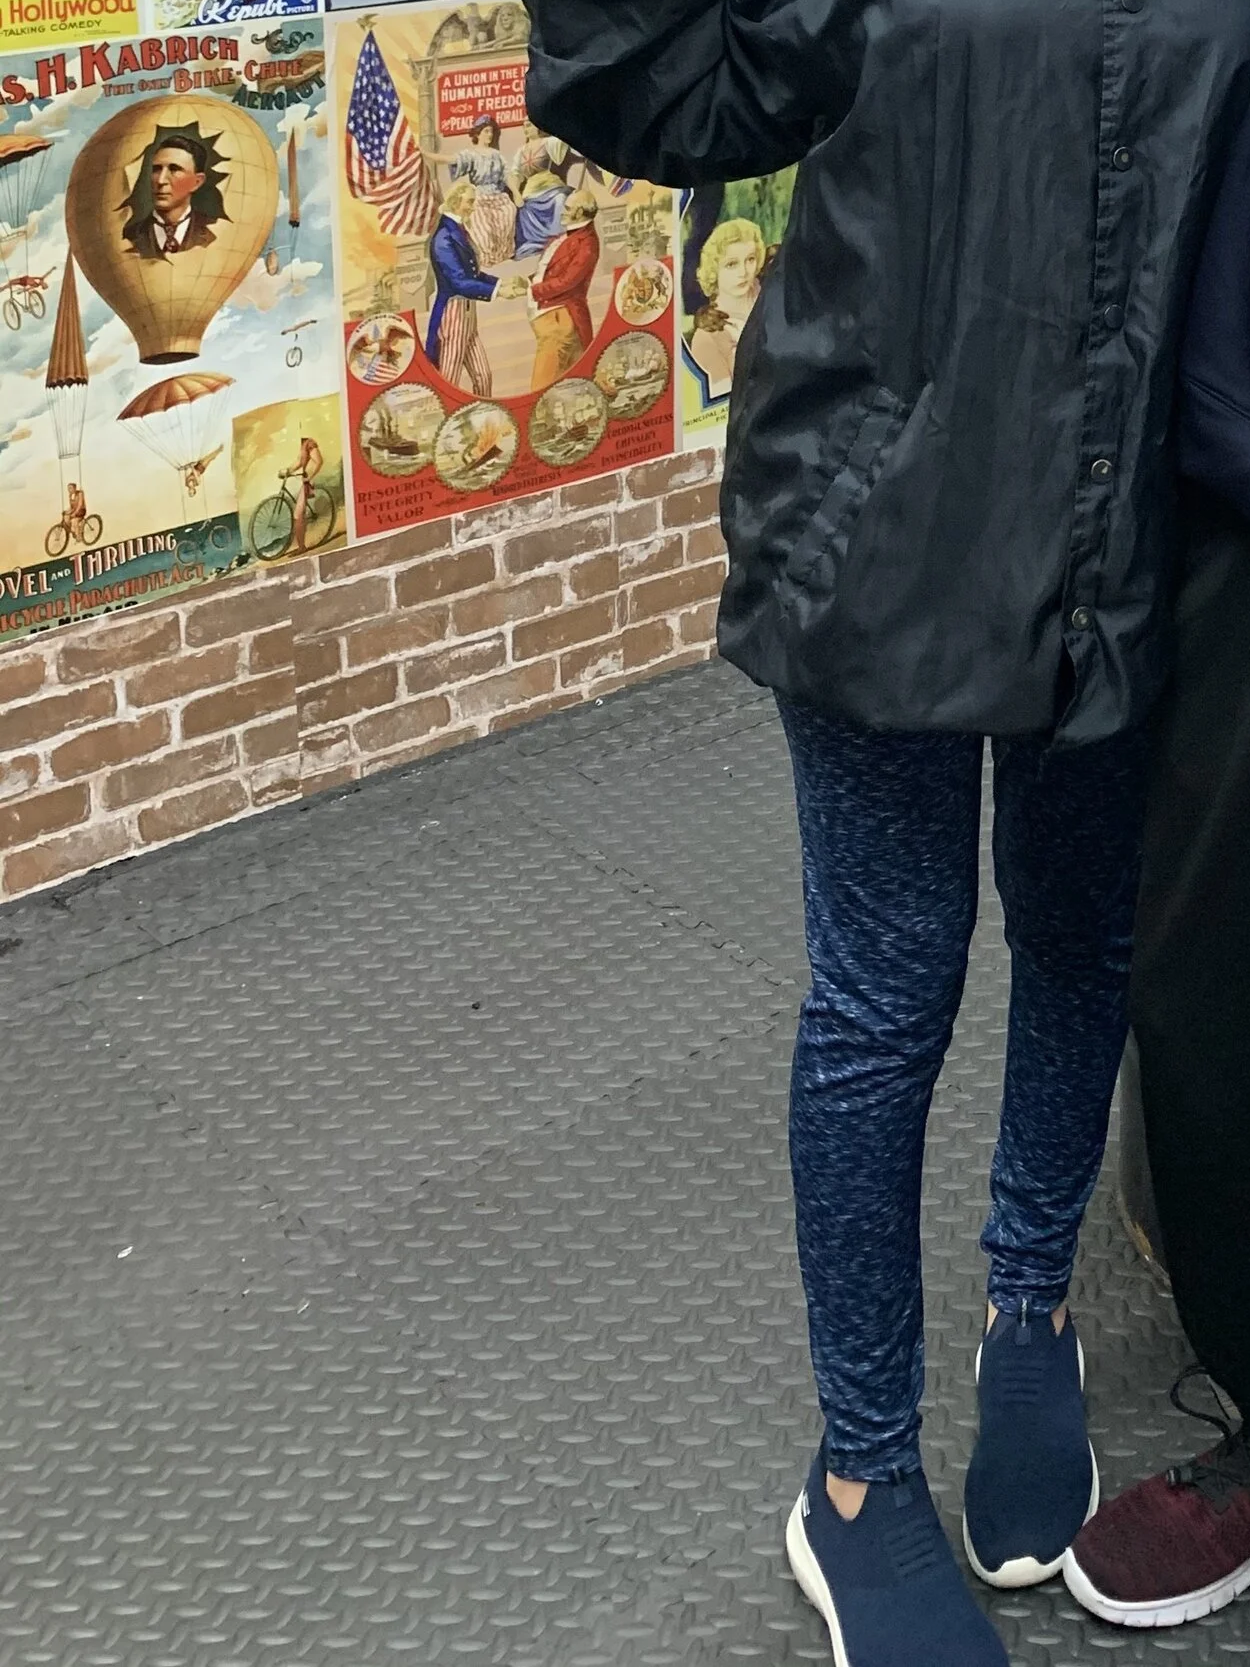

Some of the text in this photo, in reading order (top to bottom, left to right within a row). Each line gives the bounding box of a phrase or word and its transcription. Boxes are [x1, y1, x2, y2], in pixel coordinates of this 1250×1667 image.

[50, 19, 102, 32] COMEDY
[35, 35, 239, 100] H. KABRICH
[454, 72, 487, 87] UNION
[489, 70, 499, 82] IN
[500, 68, 518, 80] THE
[357, 477, 436, 503] RESOURCES
[363, 490, 433, 517] INTEGRITY
[377, 506, 425, 525] VALOR
[51, 533, 177, 586] AND THRILLING
[69, 569, 169, 615] PARACHUTE
[171, 563, 206, 585] ACT
